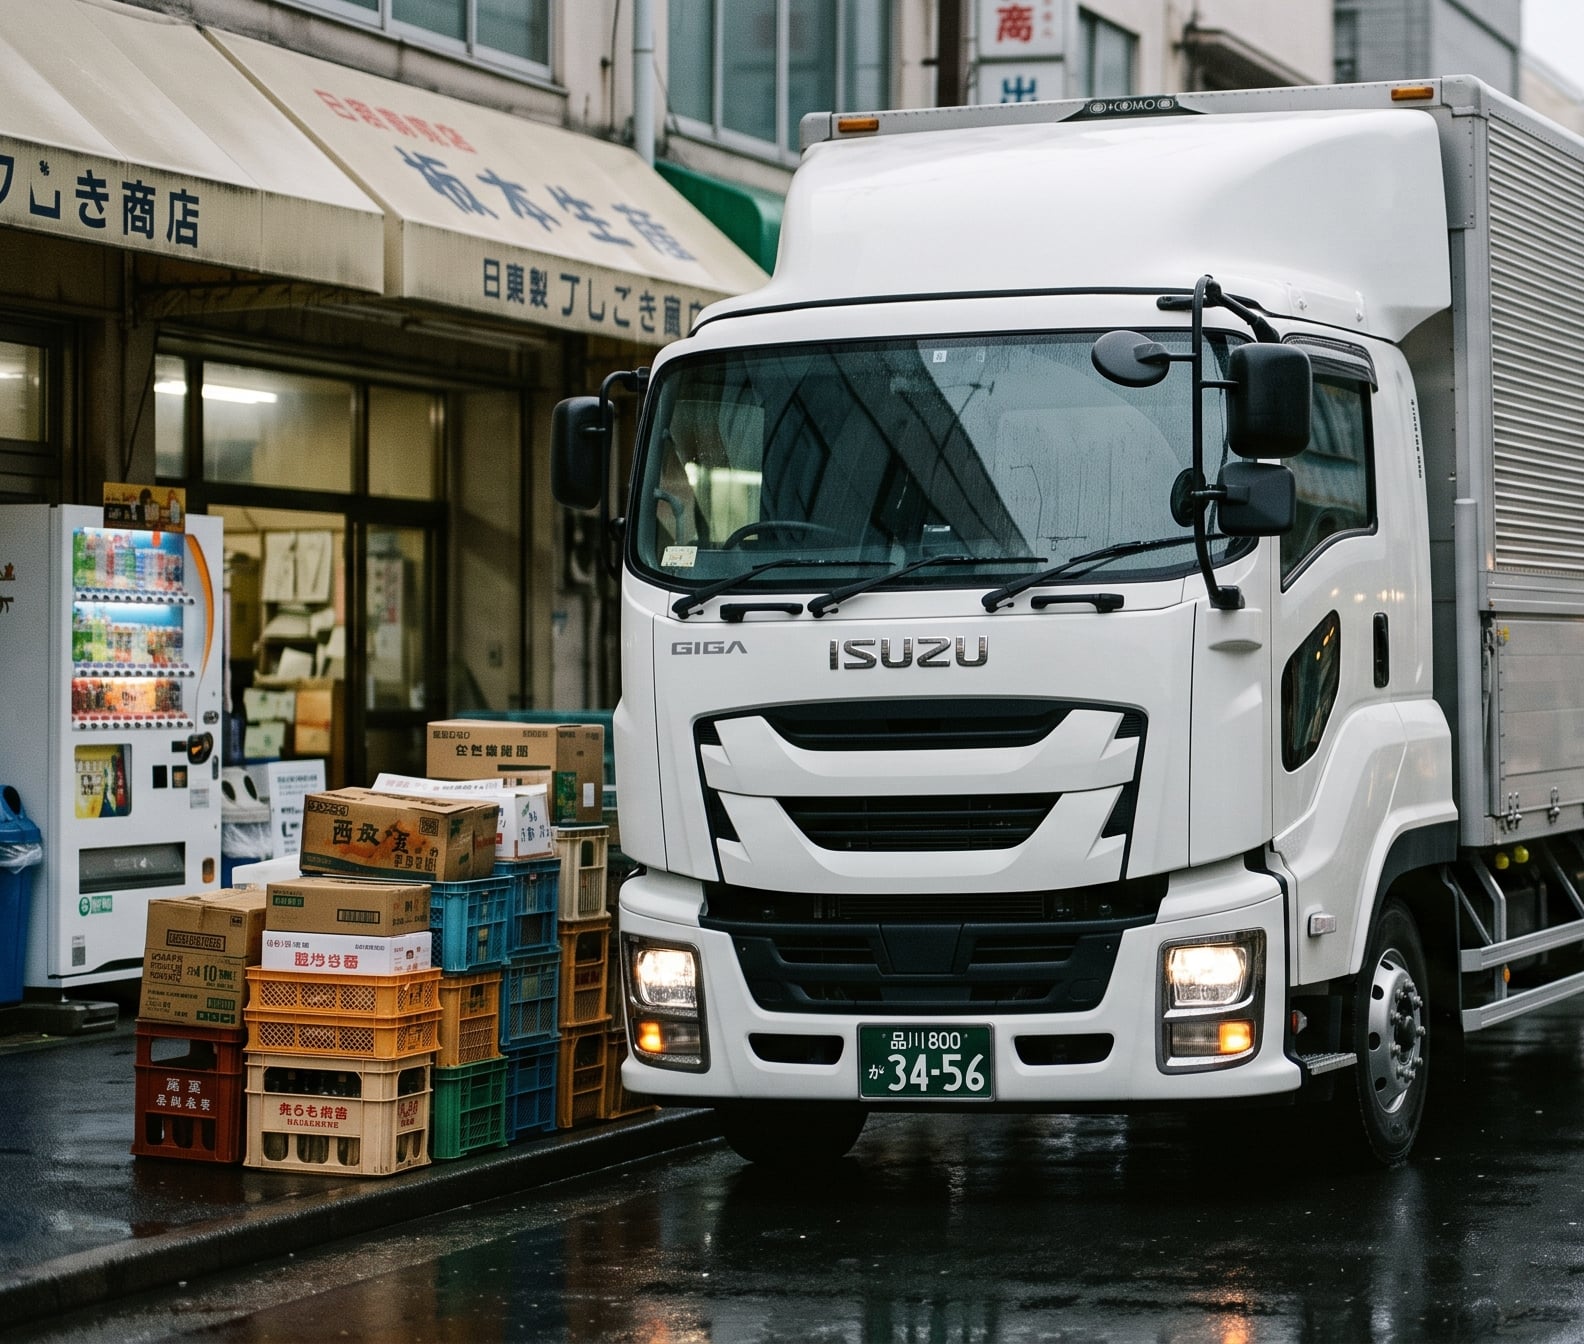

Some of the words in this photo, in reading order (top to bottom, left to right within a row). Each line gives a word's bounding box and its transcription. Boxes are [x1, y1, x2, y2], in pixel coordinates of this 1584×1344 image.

[671, 640, 749, 656] GIGA
[829, 634, 990, 671] ISUZU
[887, 1053, 985, 1092] 34-56
